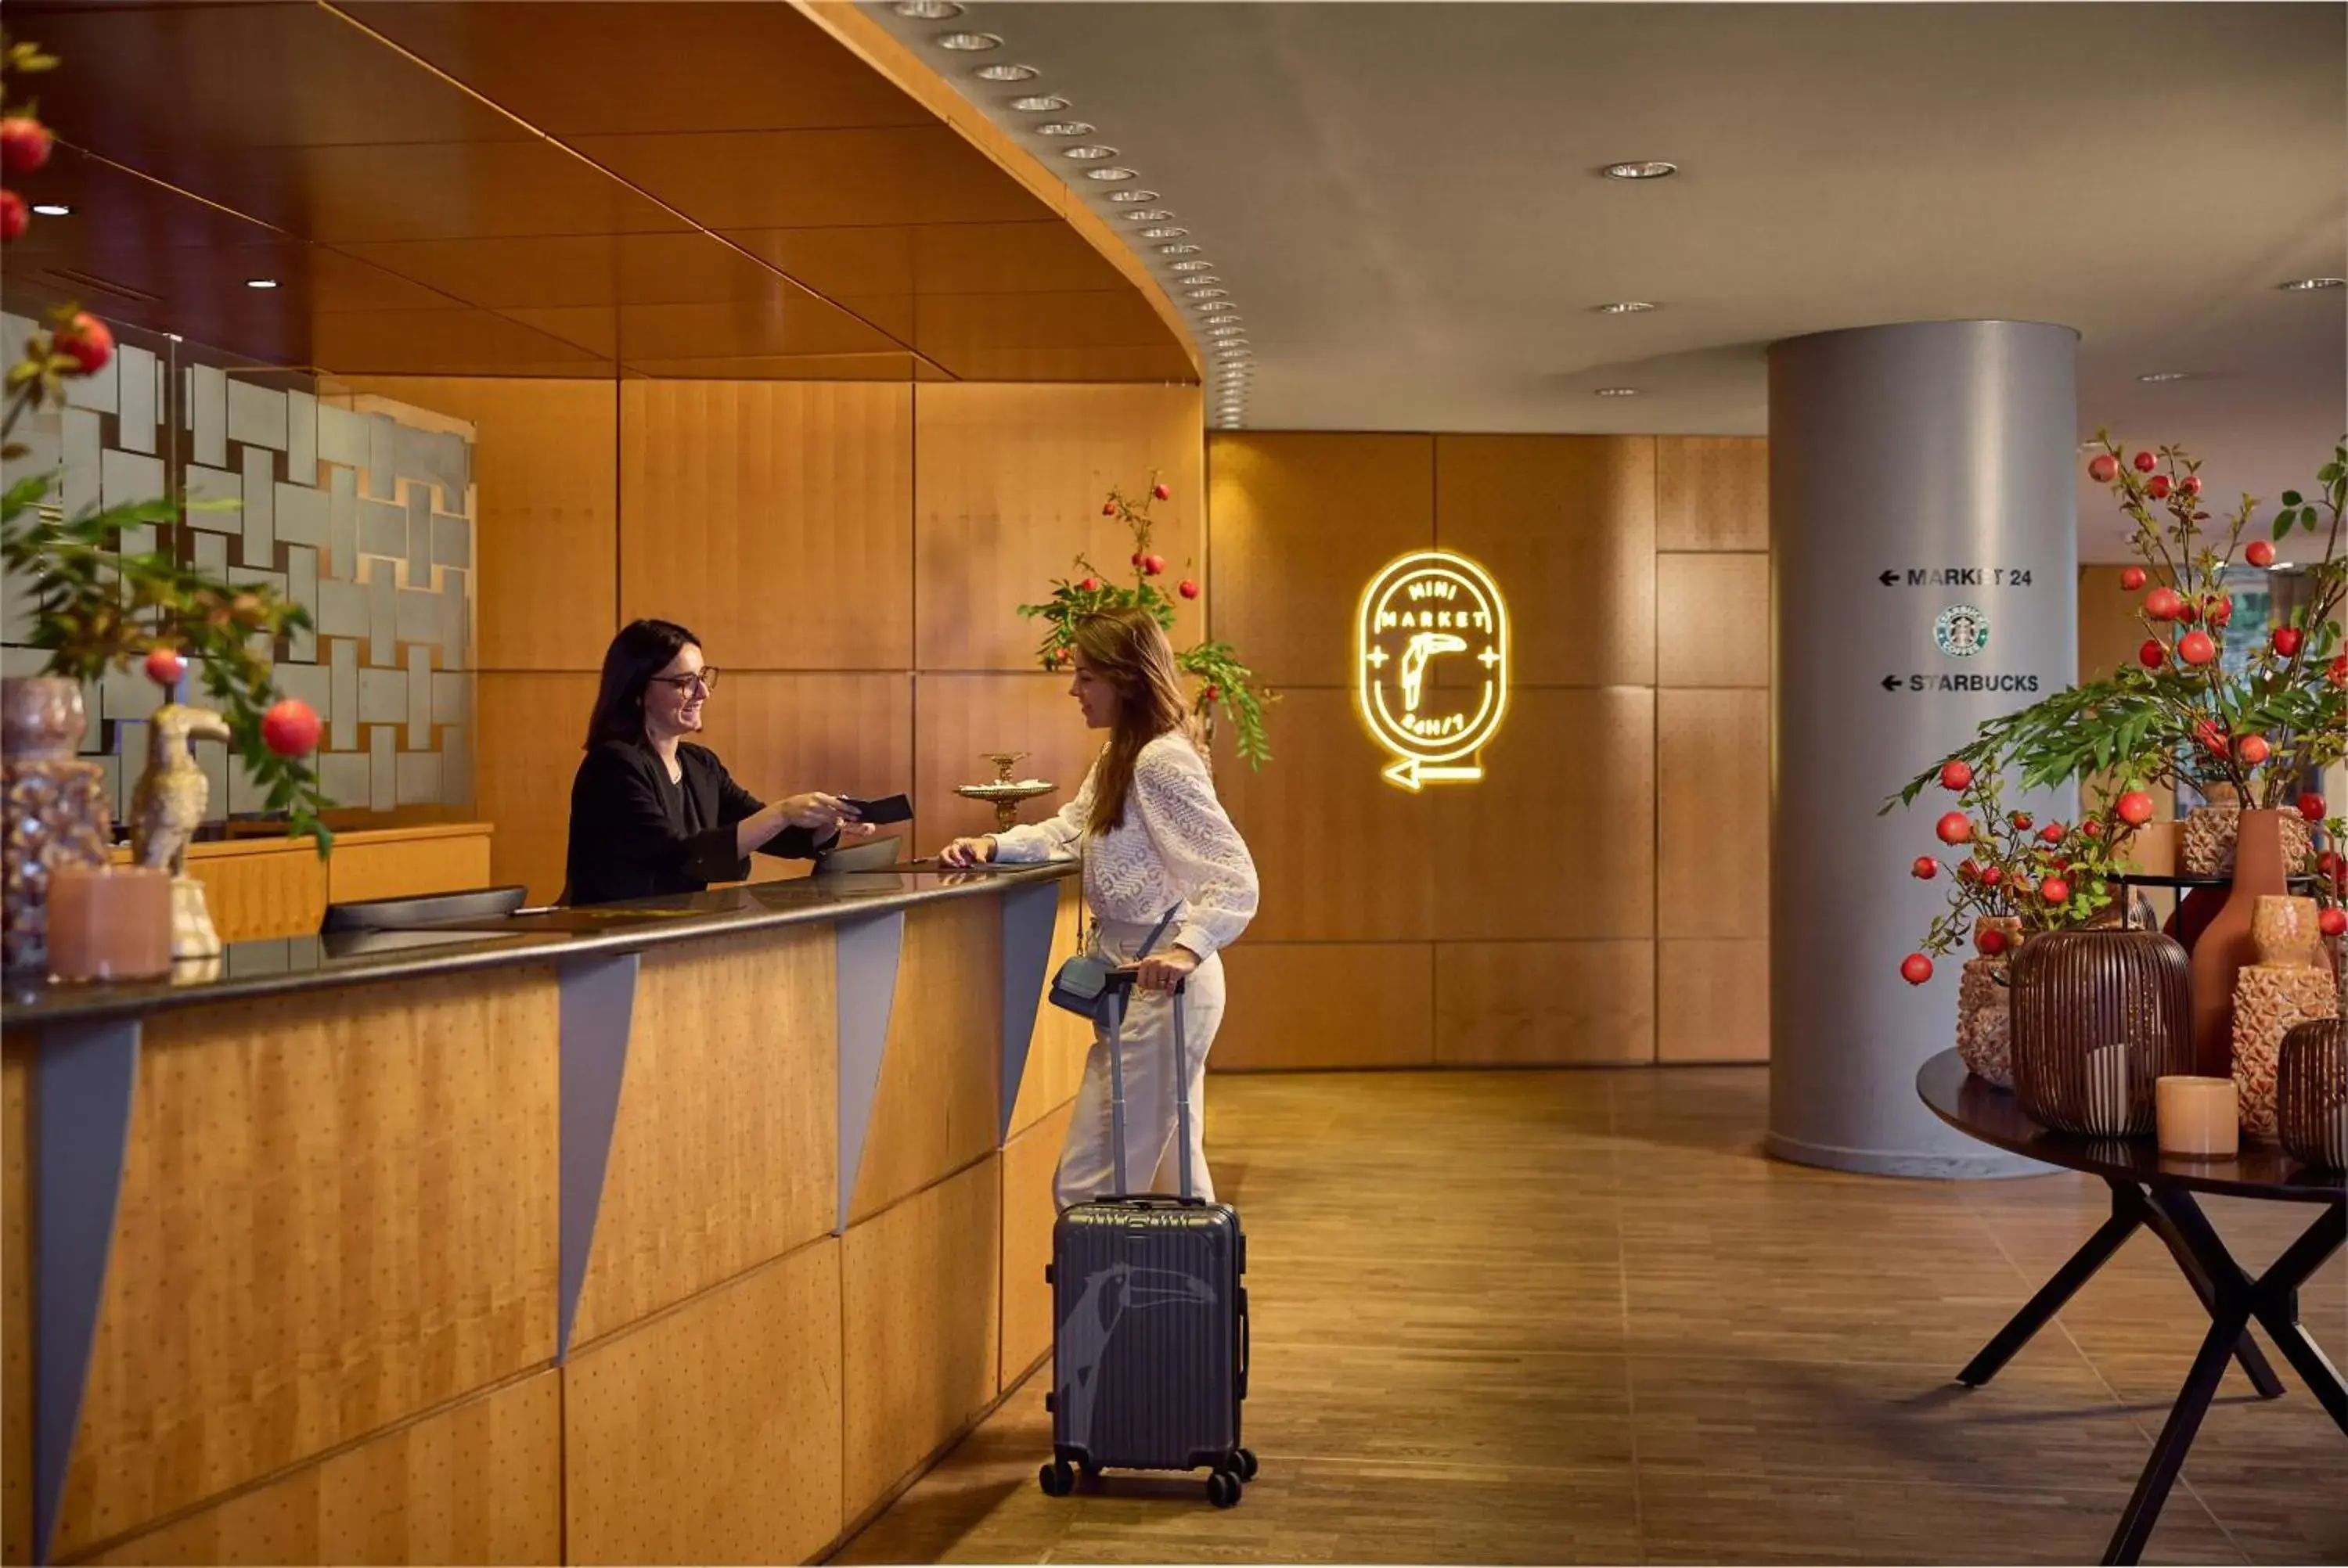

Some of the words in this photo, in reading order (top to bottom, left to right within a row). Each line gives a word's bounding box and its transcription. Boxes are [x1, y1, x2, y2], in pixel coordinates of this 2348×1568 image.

[2009, 570, 2032, 586] 24
[1409, 581, 1457, 601] MINI
[1381, 611, 1486, 628] MARKET
[1910, 674, 2039, 692] STARBUCKS
